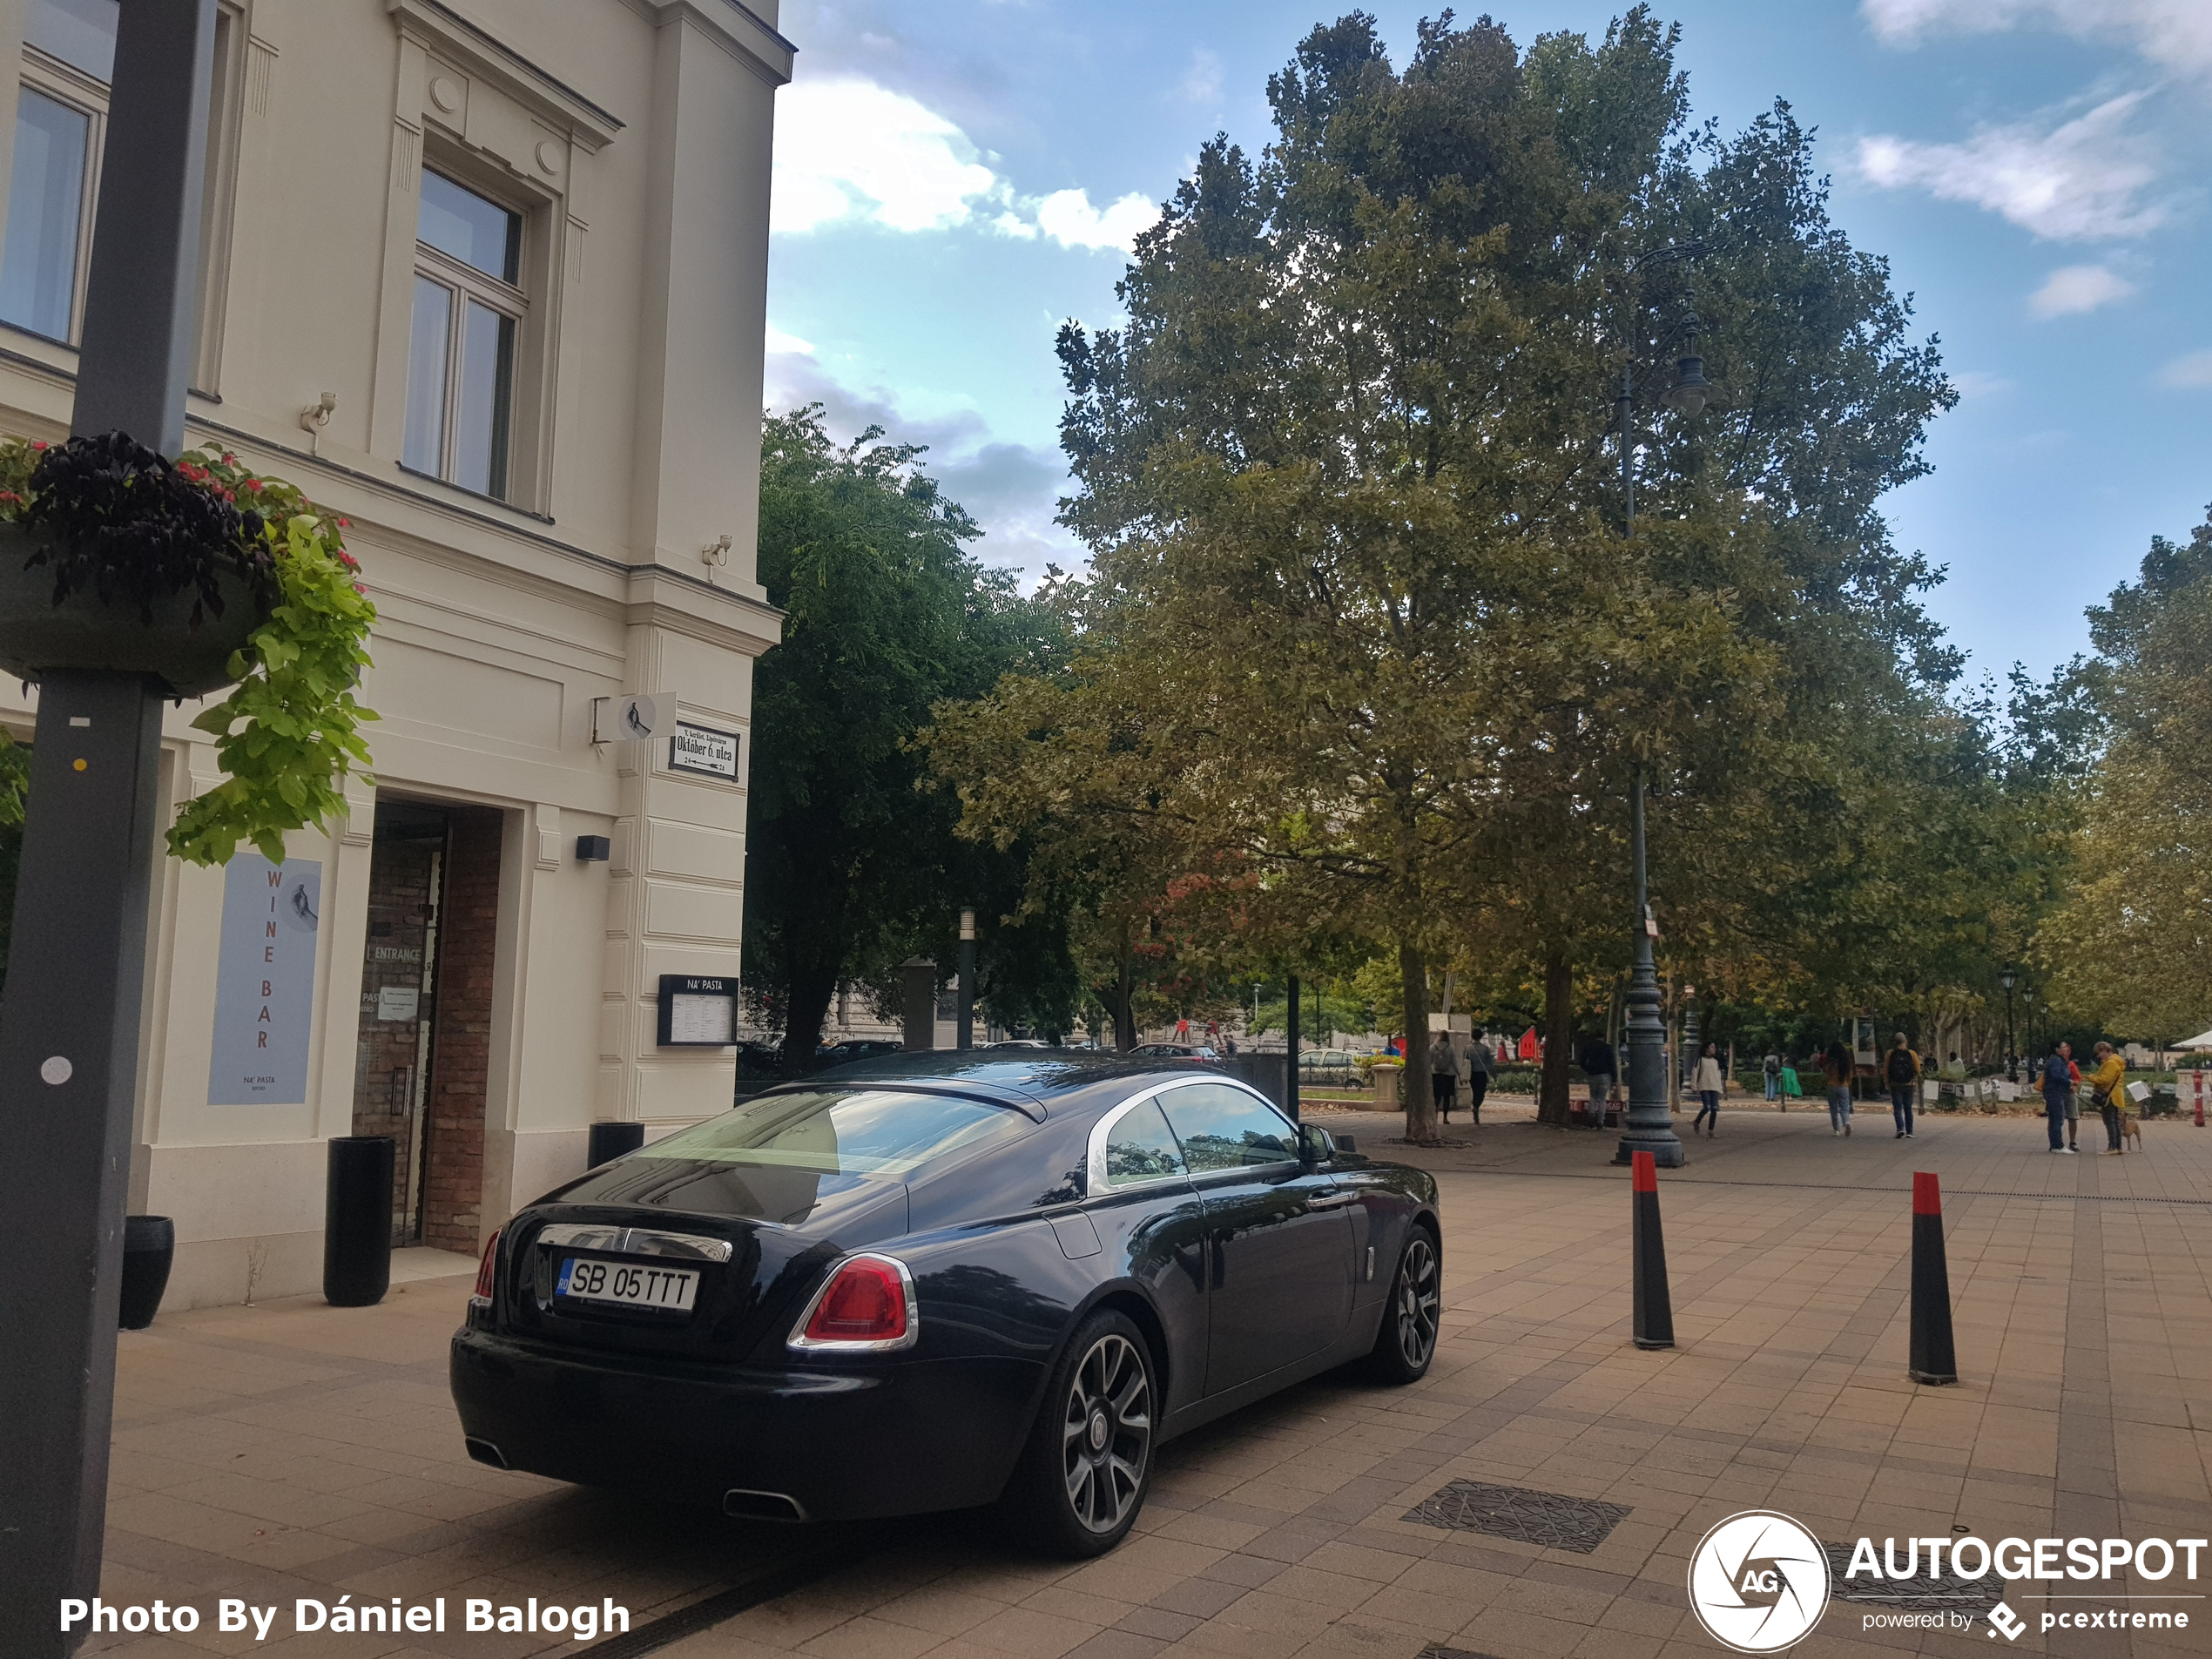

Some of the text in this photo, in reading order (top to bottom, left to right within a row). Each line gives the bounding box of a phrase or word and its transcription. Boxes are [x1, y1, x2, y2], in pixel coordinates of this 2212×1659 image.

[678, 736, 732, 761] Október 6. ulca
[257, 871, 283, 1049] WINE BAR
[374, 947, 421, 961] ENTRANCE
[702, 980, 722, 990] PASTA
[558, 1278, 569, 1291] RO
[572, 1264, 607, 1295] SB
